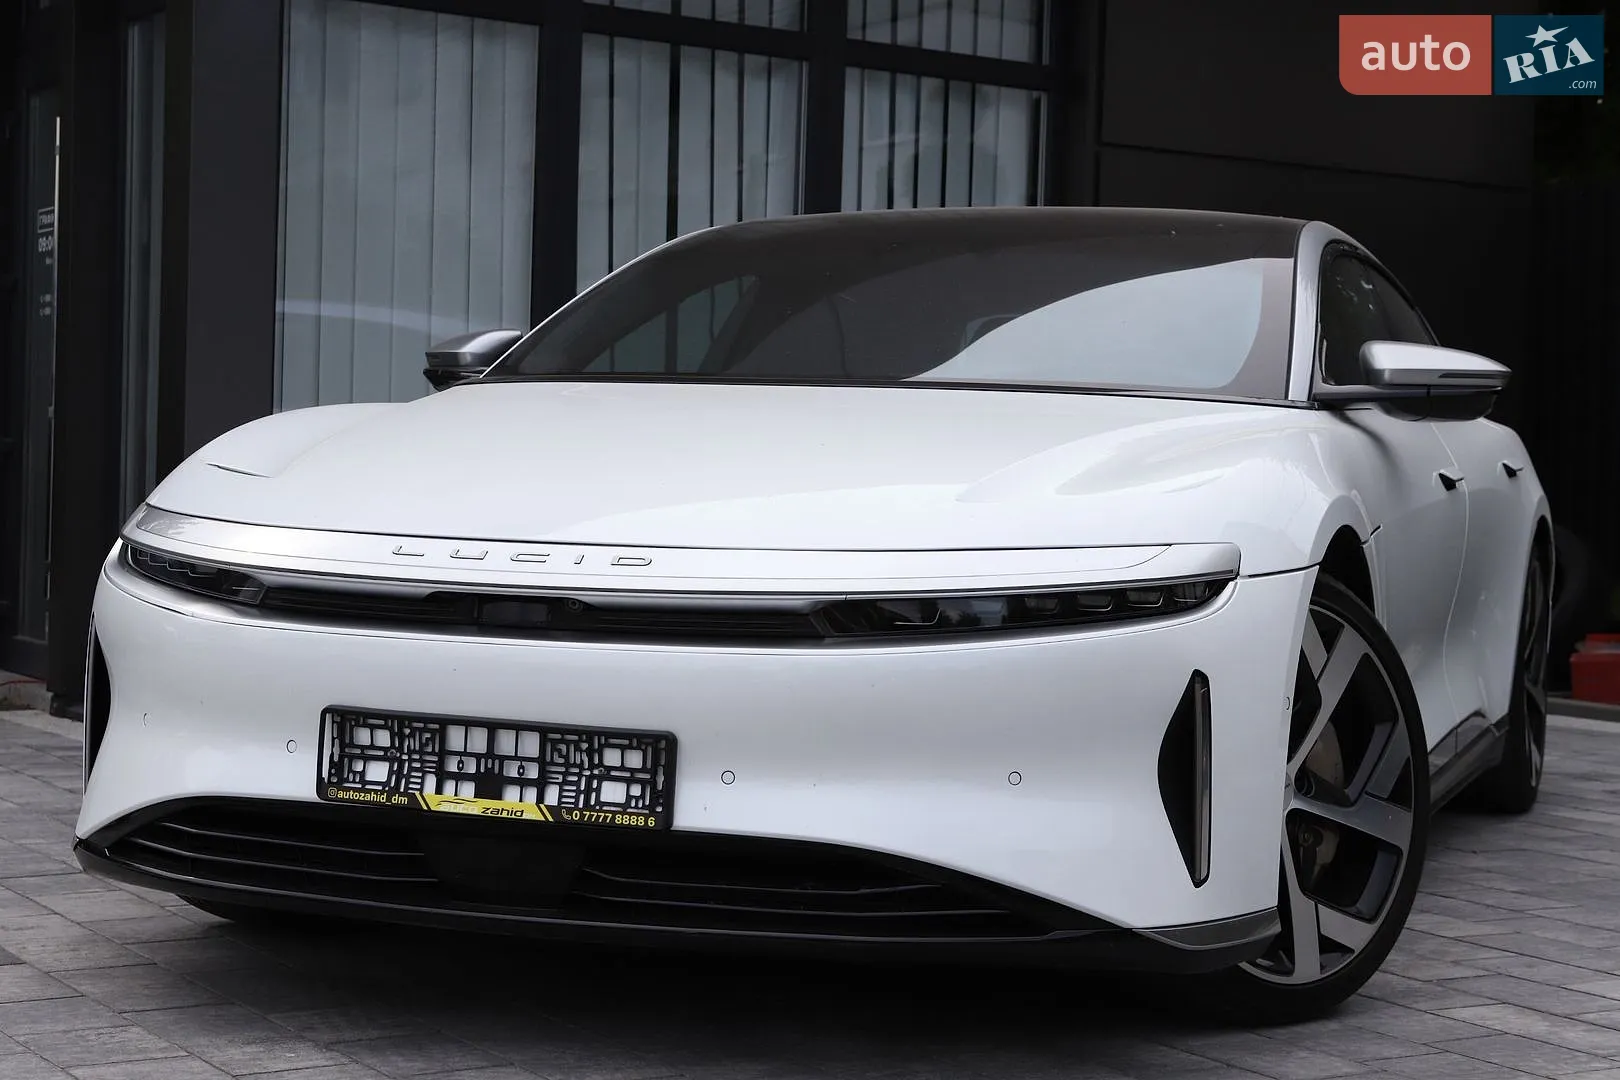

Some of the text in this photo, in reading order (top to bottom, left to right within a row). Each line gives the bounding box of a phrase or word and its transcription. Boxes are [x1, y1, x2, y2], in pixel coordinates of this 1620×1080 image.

[392, 545, 652, 567] LUCID
[480, 806, 525, 818] zahid
[572, 810, 656, 827] 0 7777 8888 6
